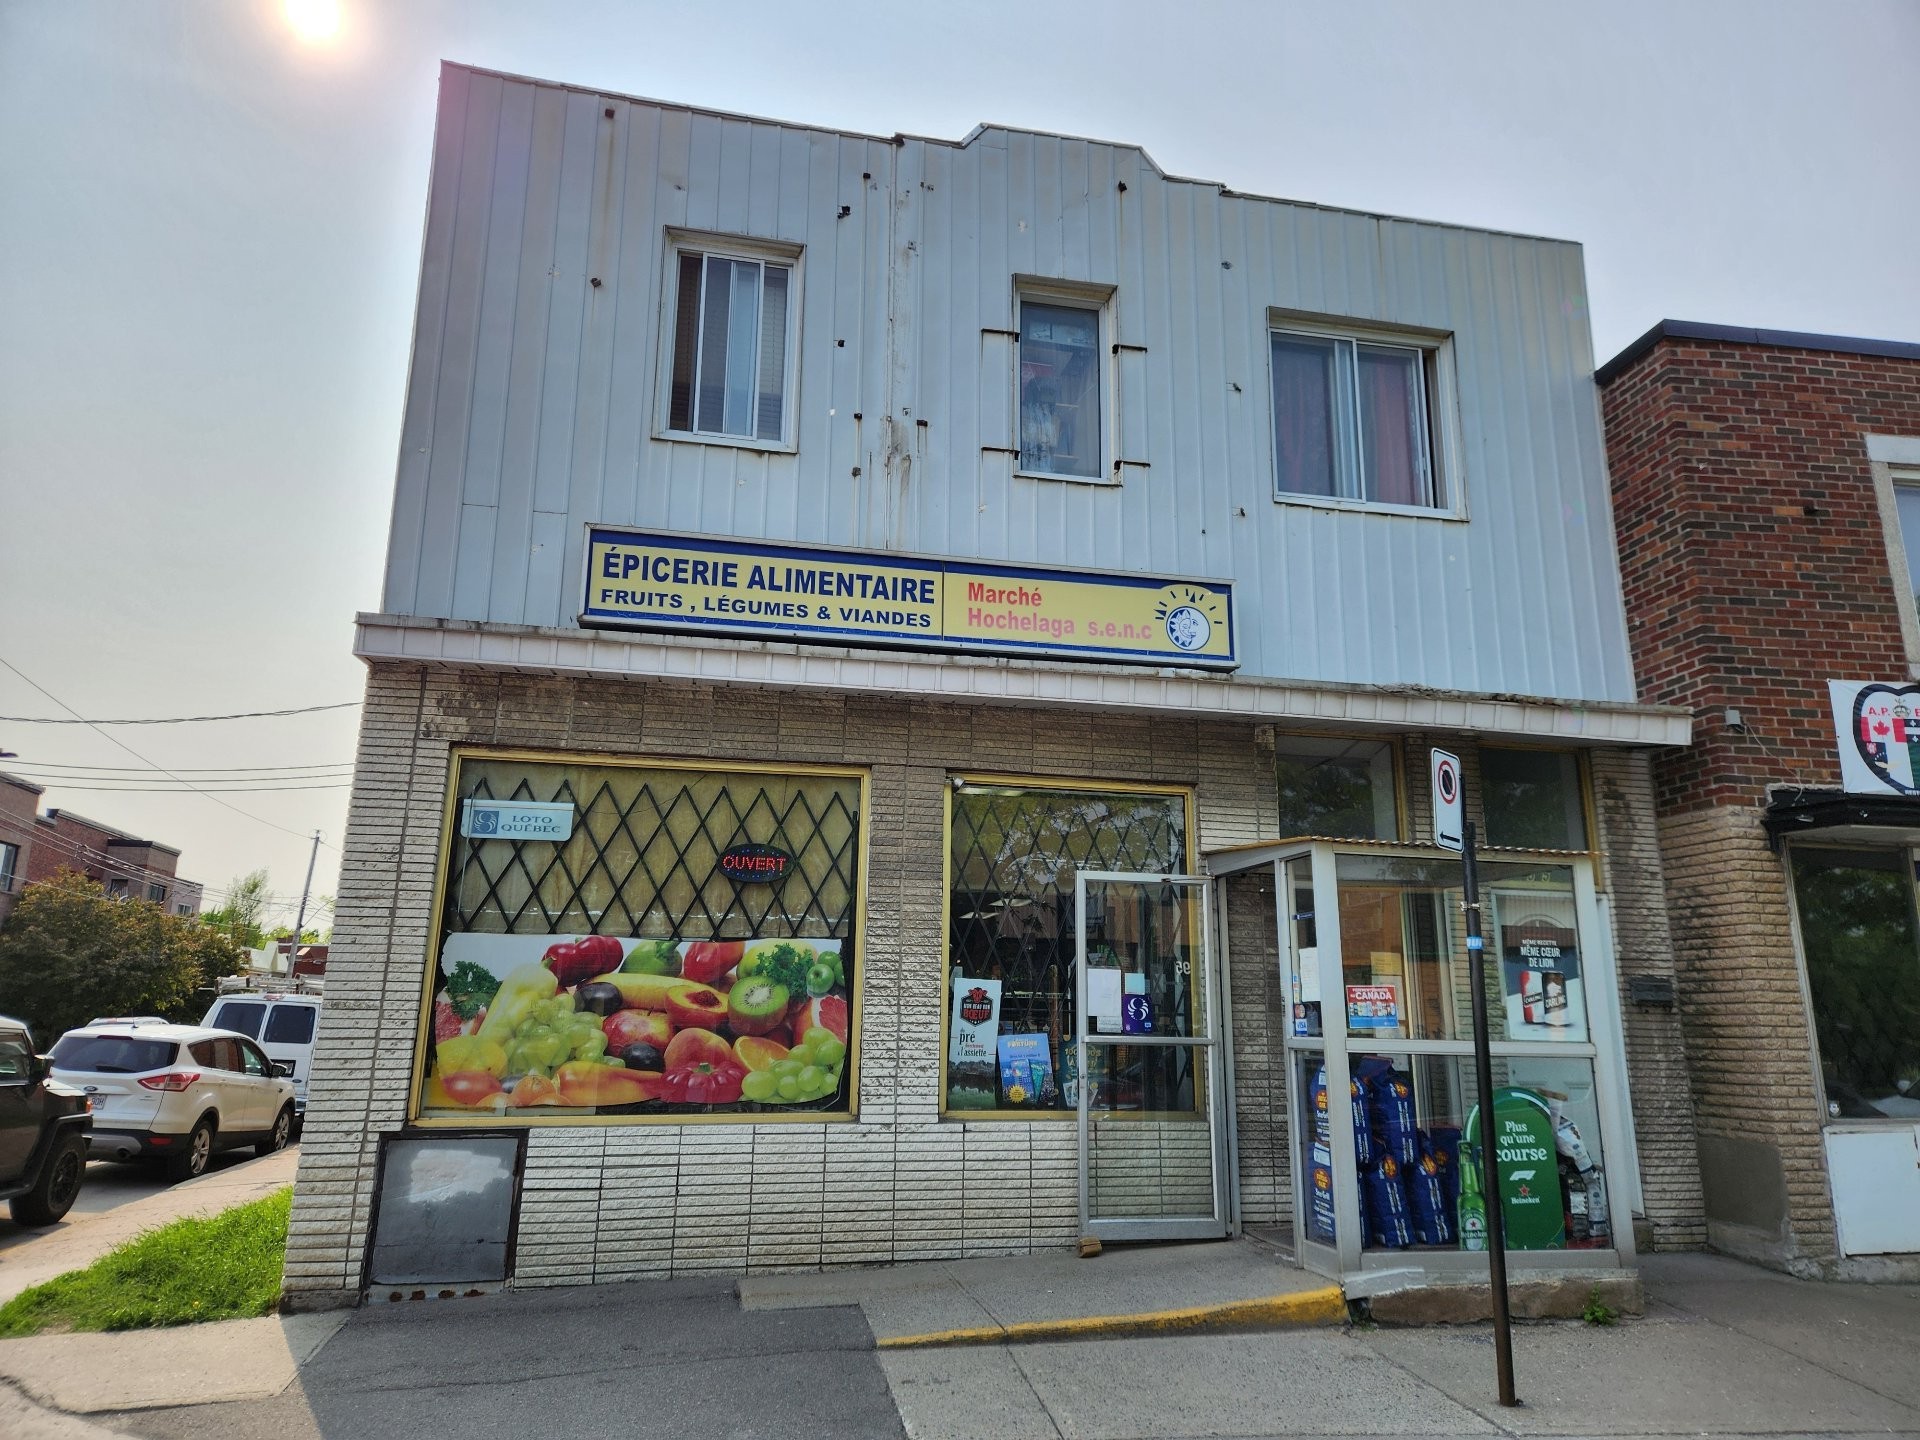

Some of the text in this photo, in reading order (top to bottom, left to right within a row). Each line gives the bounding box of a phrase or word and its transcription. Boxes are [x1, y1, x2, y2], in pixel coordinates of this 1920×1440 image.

[603, 546, 935, 604] ÉPICERIE ALIMENTAIRE
[968, 581, 1042, 607] Marché
[704, 595, 809, 619] LÉGUMES
[817, 606, 832, 620] &
[839, 608, 931, 628] VIANDES
[968, 607, 1075, 640] Hochelaga
[512, 815, 553, 825] LOTO
[501, 823, 561, 834] QUÉBEC
[723, 854, 786, 872] OUVERT
[1520, 945, 1540, 957] MÊME
[1528, 957, 1555, 969] DE LION
[1356, 991, 1392, 1000] CANADA
[1297, 1021, 1307, 1029] VISA
[959, 1031, 975, 1045] pré
[1505, 1121, 1528, 1133] Plus
[1500, 1133, 1535, 1146] qu'une
[1511, 1196, 1540, 1204] Heineken
